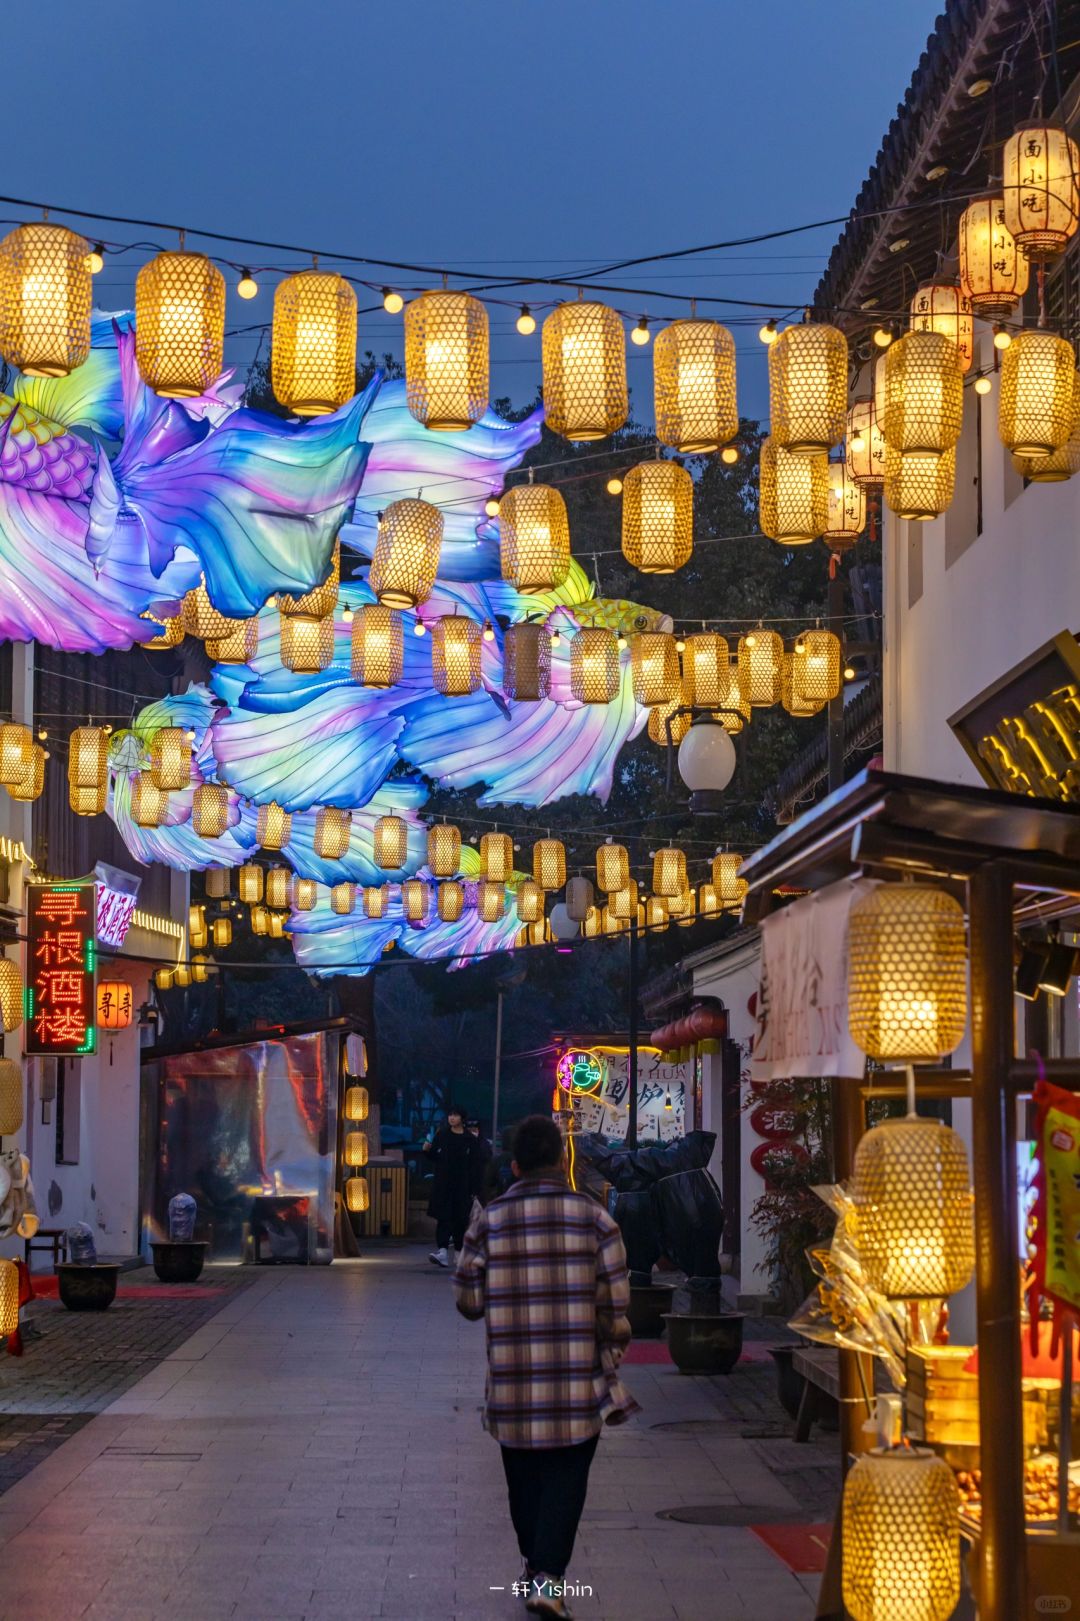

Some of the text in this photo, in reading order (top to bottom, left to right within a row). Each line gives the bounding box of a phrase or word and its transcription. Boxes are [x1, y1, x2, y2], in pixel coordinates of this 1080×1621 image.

[35, 892, 88, 1044] 寻根酒楼
[98, 992, 116, 1019] 寻
